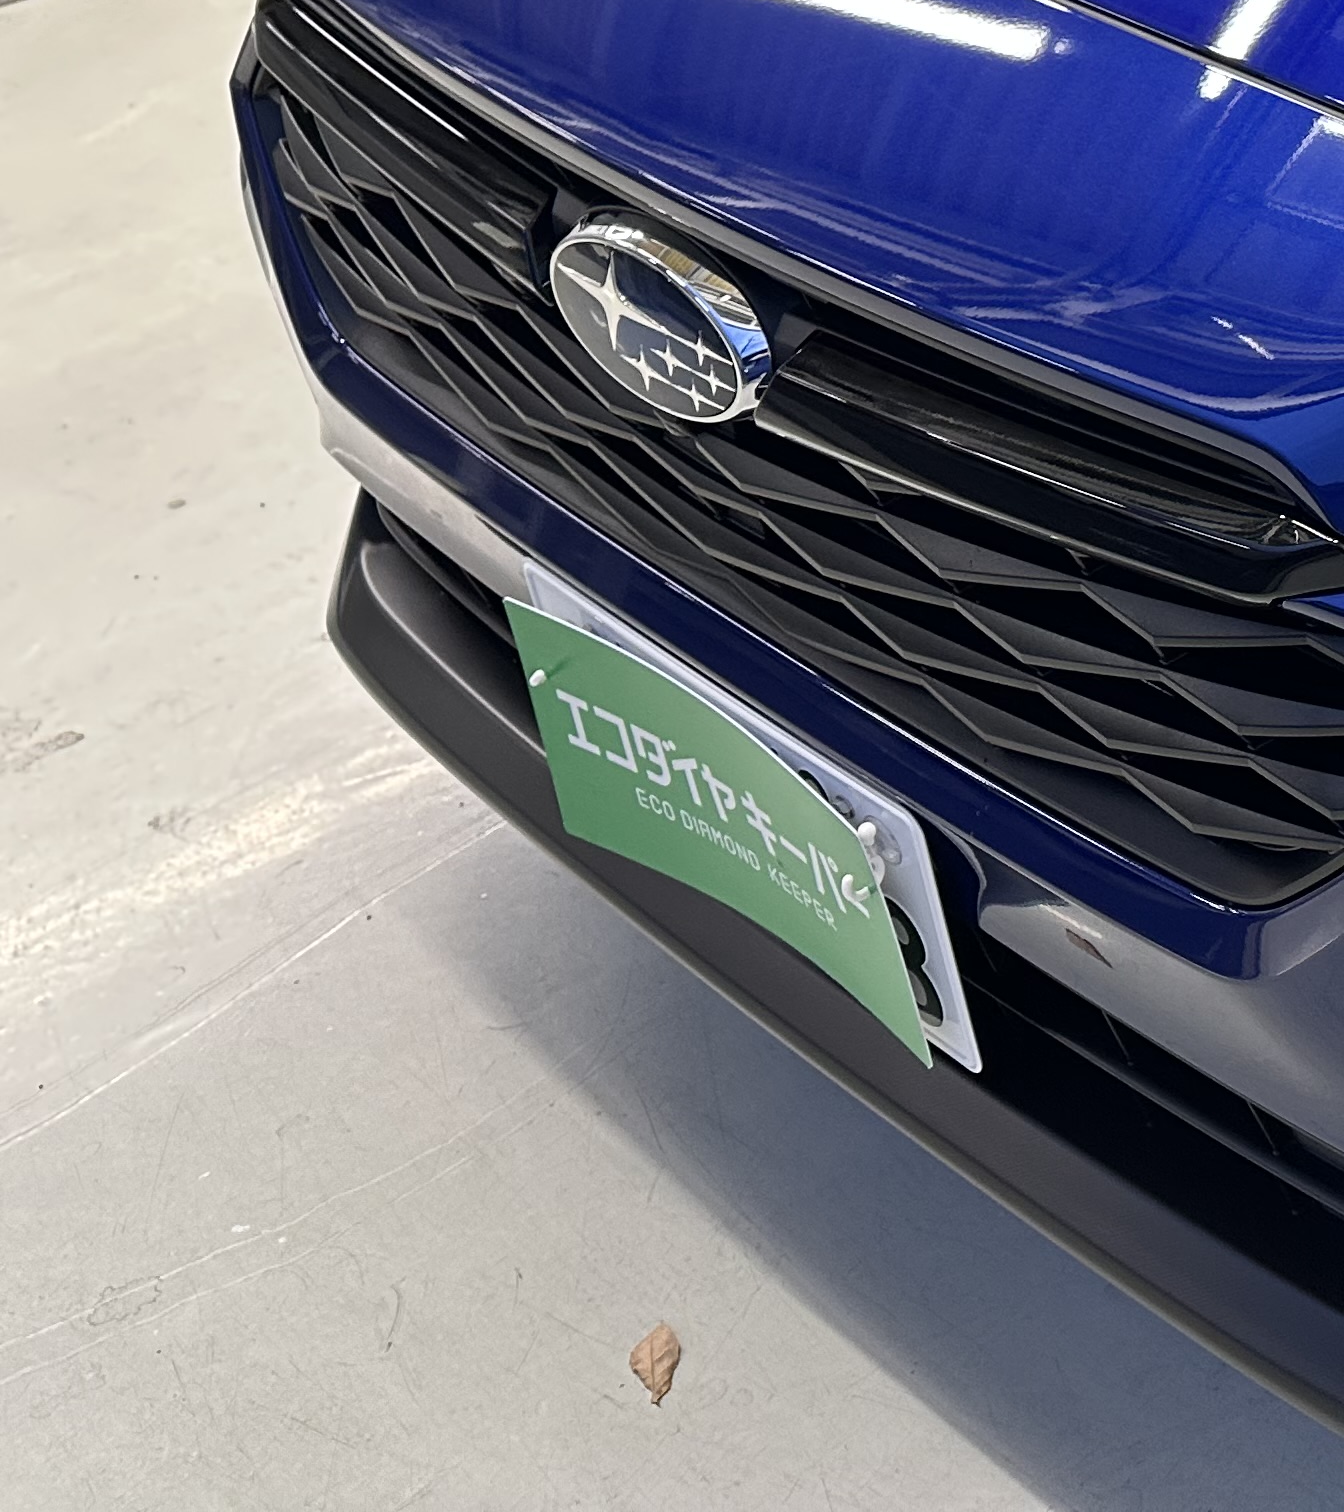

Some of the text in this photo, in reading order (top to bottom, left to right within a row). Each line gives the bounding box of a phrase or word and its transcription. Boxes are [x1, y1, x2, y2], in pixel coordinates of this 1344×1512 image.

[635, 787, 837, 931] ECO DIAMOND KEEPER
